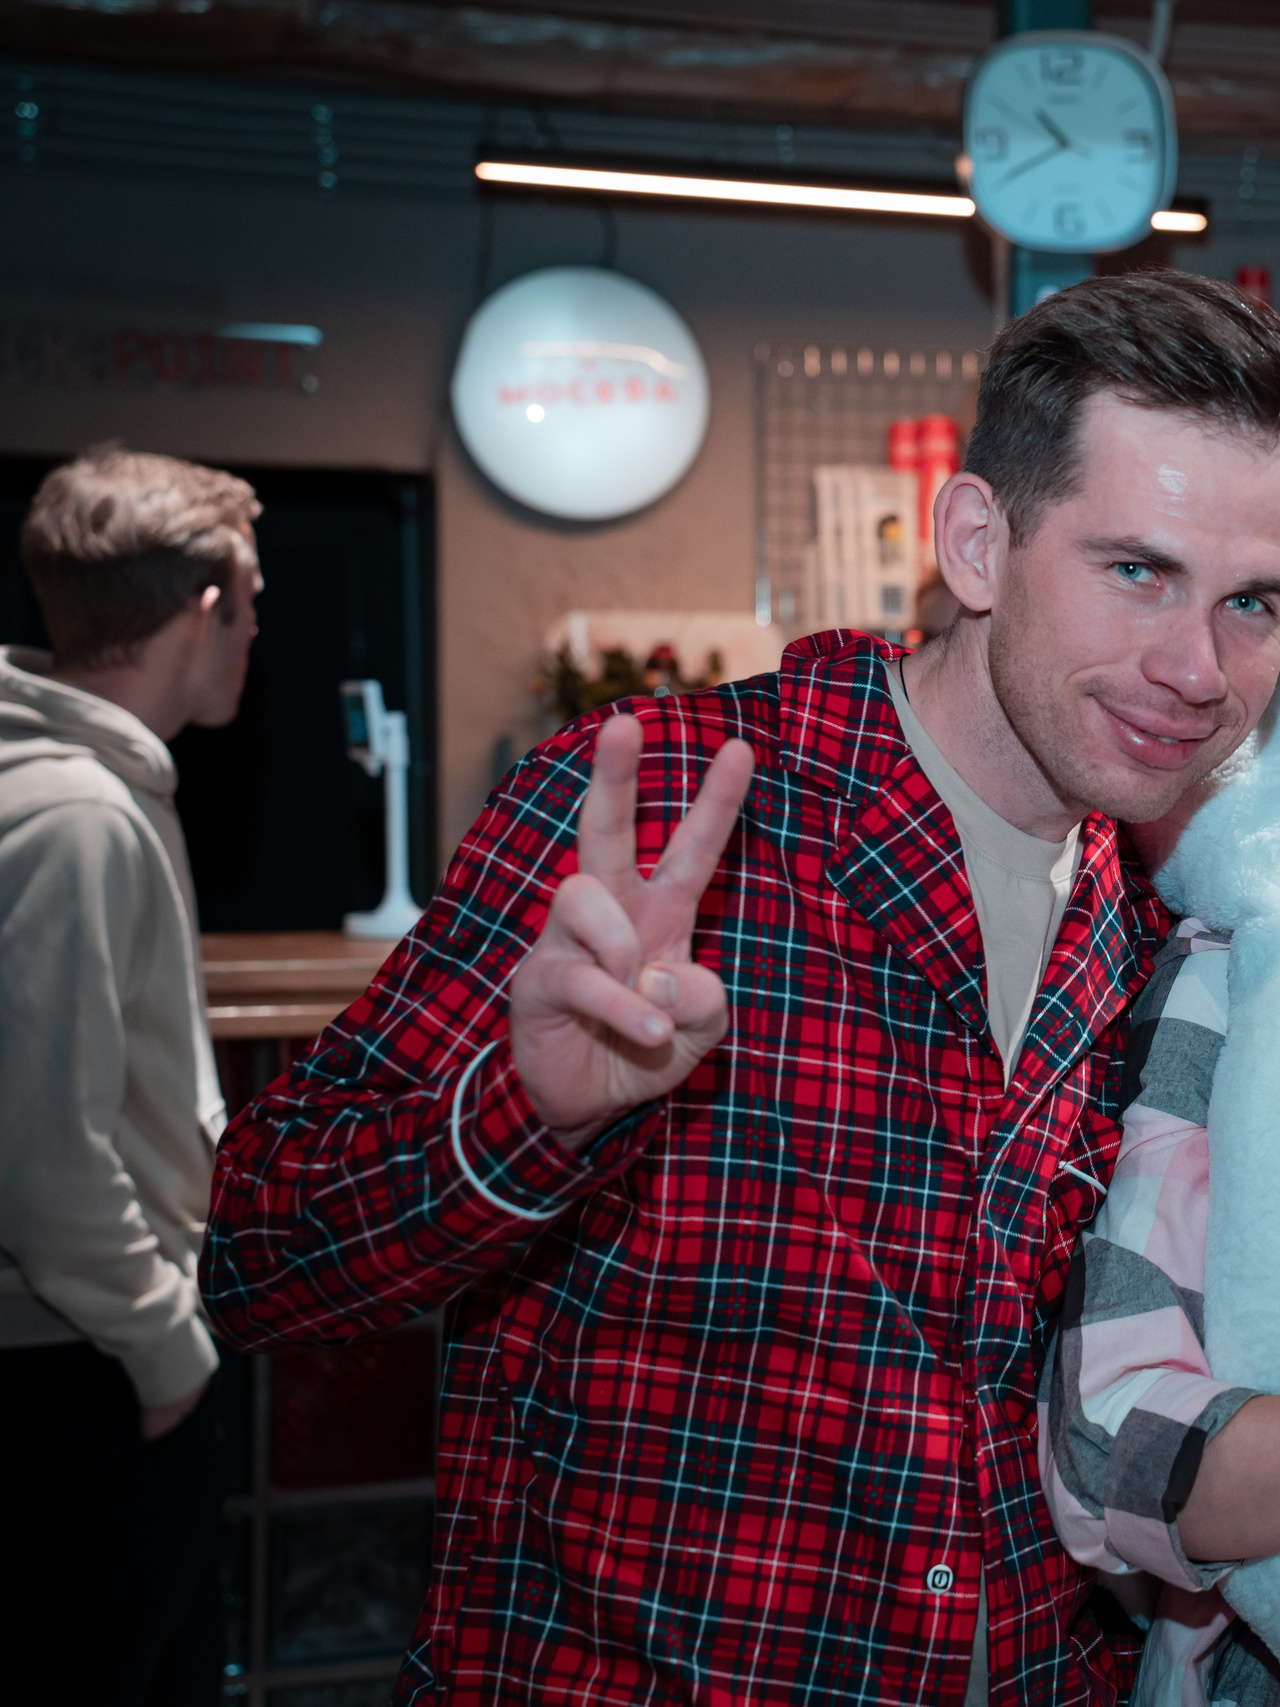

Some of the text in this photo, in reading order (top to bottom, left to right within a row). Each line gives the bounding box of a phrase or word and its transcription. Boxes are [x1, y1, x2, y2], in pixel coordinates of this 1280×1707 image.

[1040, 46, 1085, 86] 12
[975, 125, 1010, 163] 9
[1123, 127, 1157, 164] 3
[1052, 202, 1088, 240] 6
